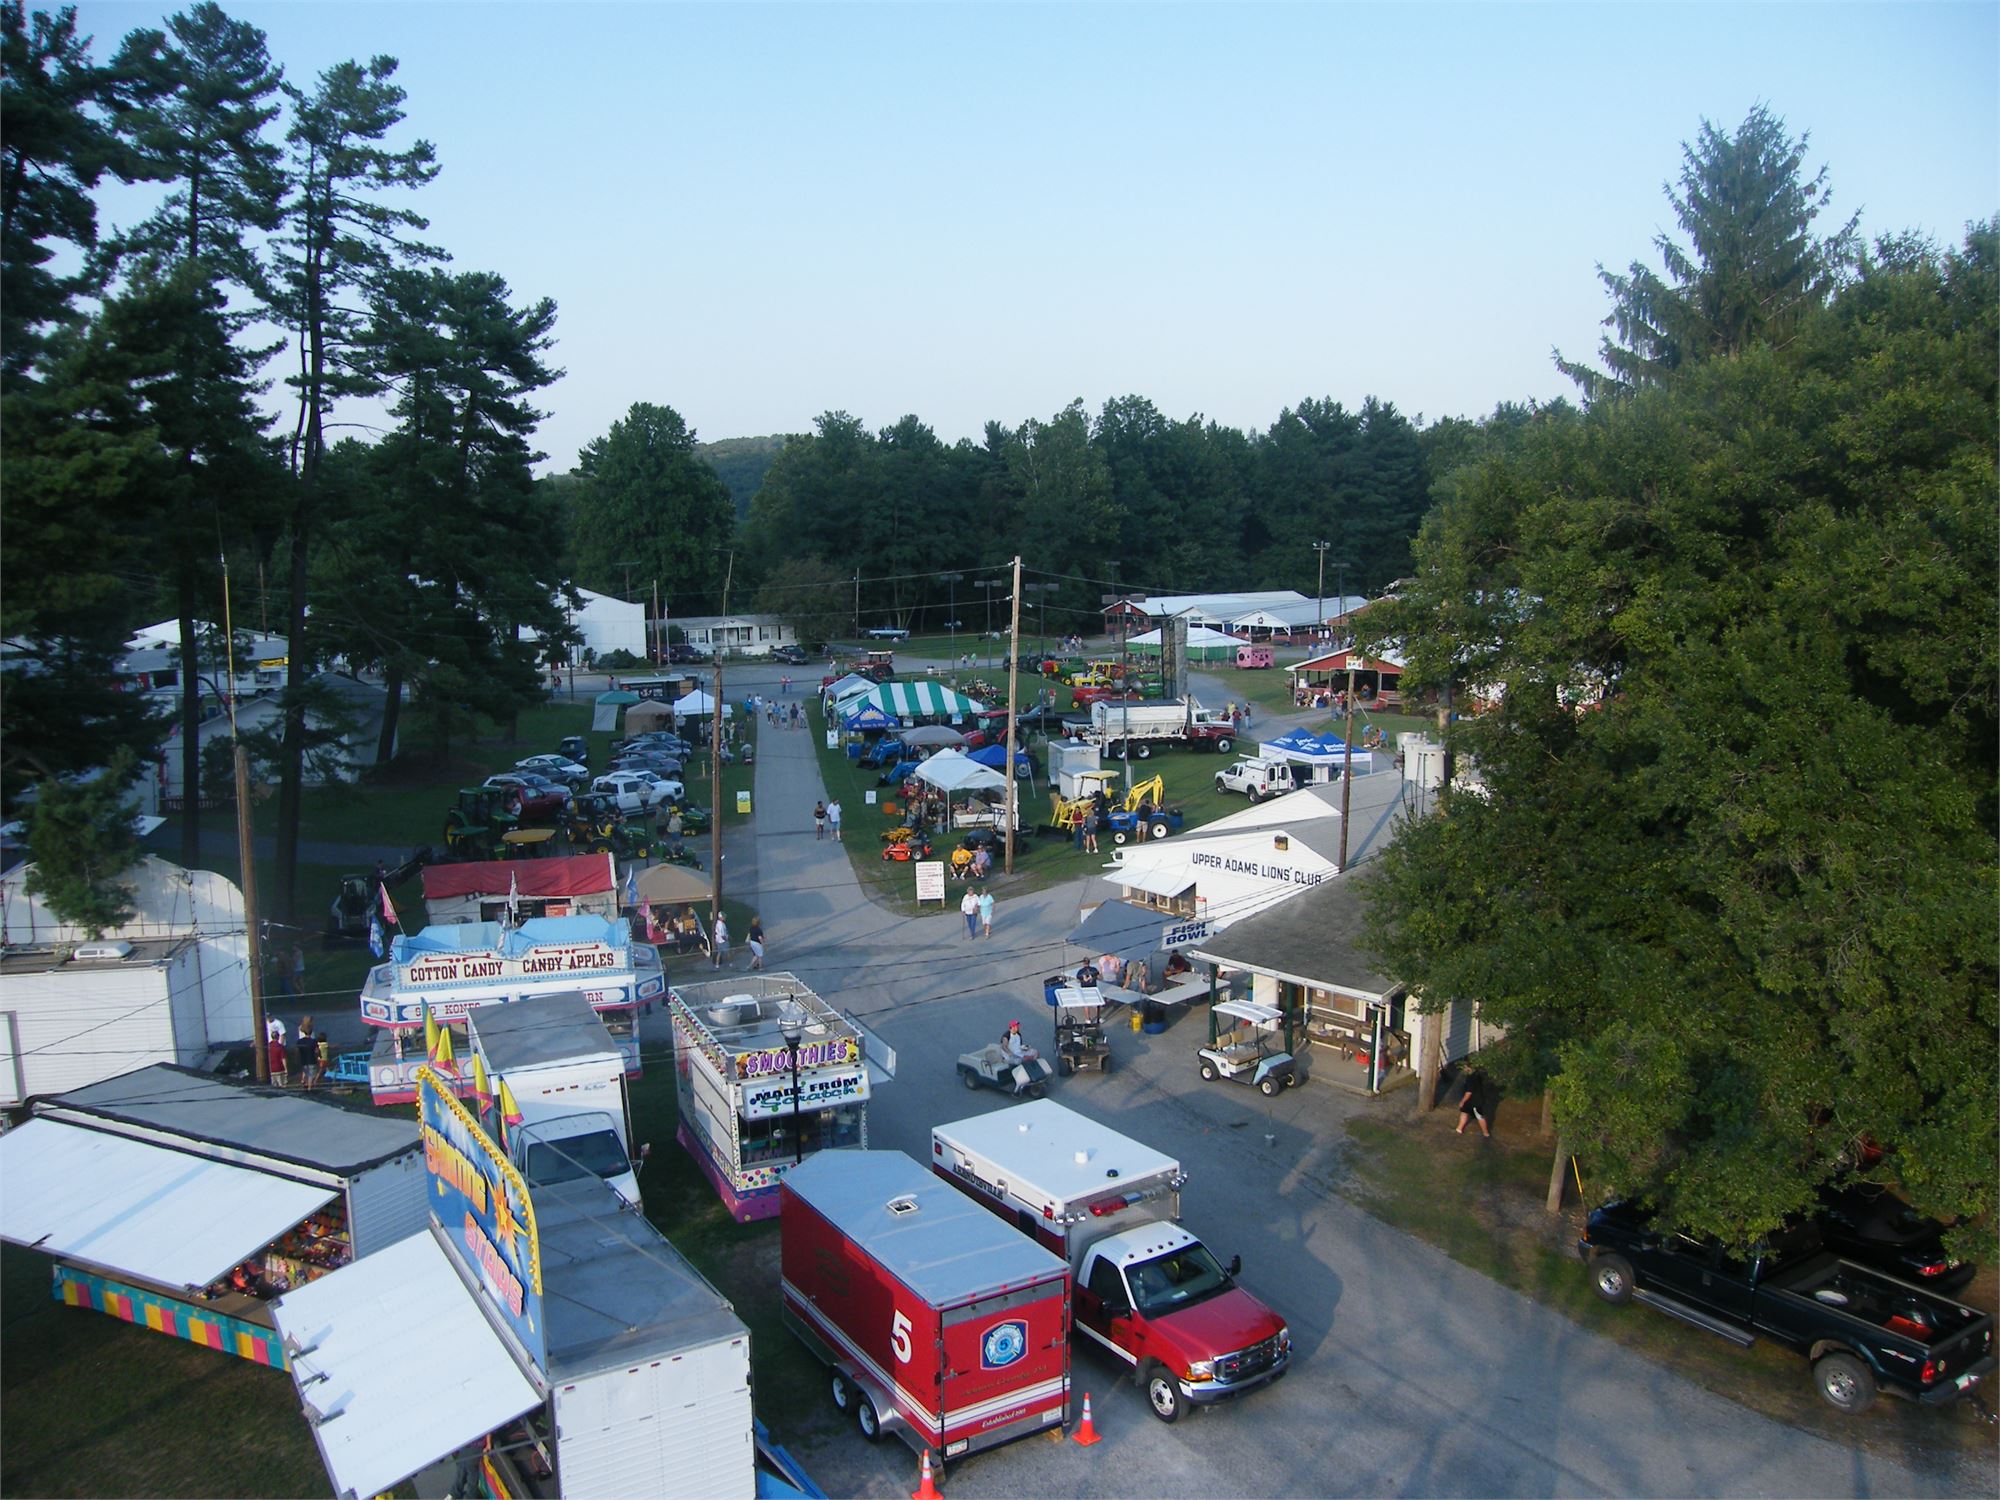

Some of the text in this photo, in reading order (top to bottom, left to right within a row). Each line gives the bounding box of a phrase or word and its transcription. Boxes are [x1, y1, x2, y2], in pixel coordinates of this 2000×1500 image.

[1192, 852, 1222, 869] UPPER
[1224, 858, 1258, 876] ADAMS
[1294, 870, 1322, 886] CLUB
[1166, 921, 1209, 945] FISH BOWL
[410, 961, 503, 982] COTTON CANDY
[522, 952, 614, 973] CANDY APPLES
[415, 1006, 437, 1017] SO
[755, 1077, 858, 1101] MADE FROM
[464, 1210, 524, 1318] STARS
[890, 1309, 912, 1363] 5
